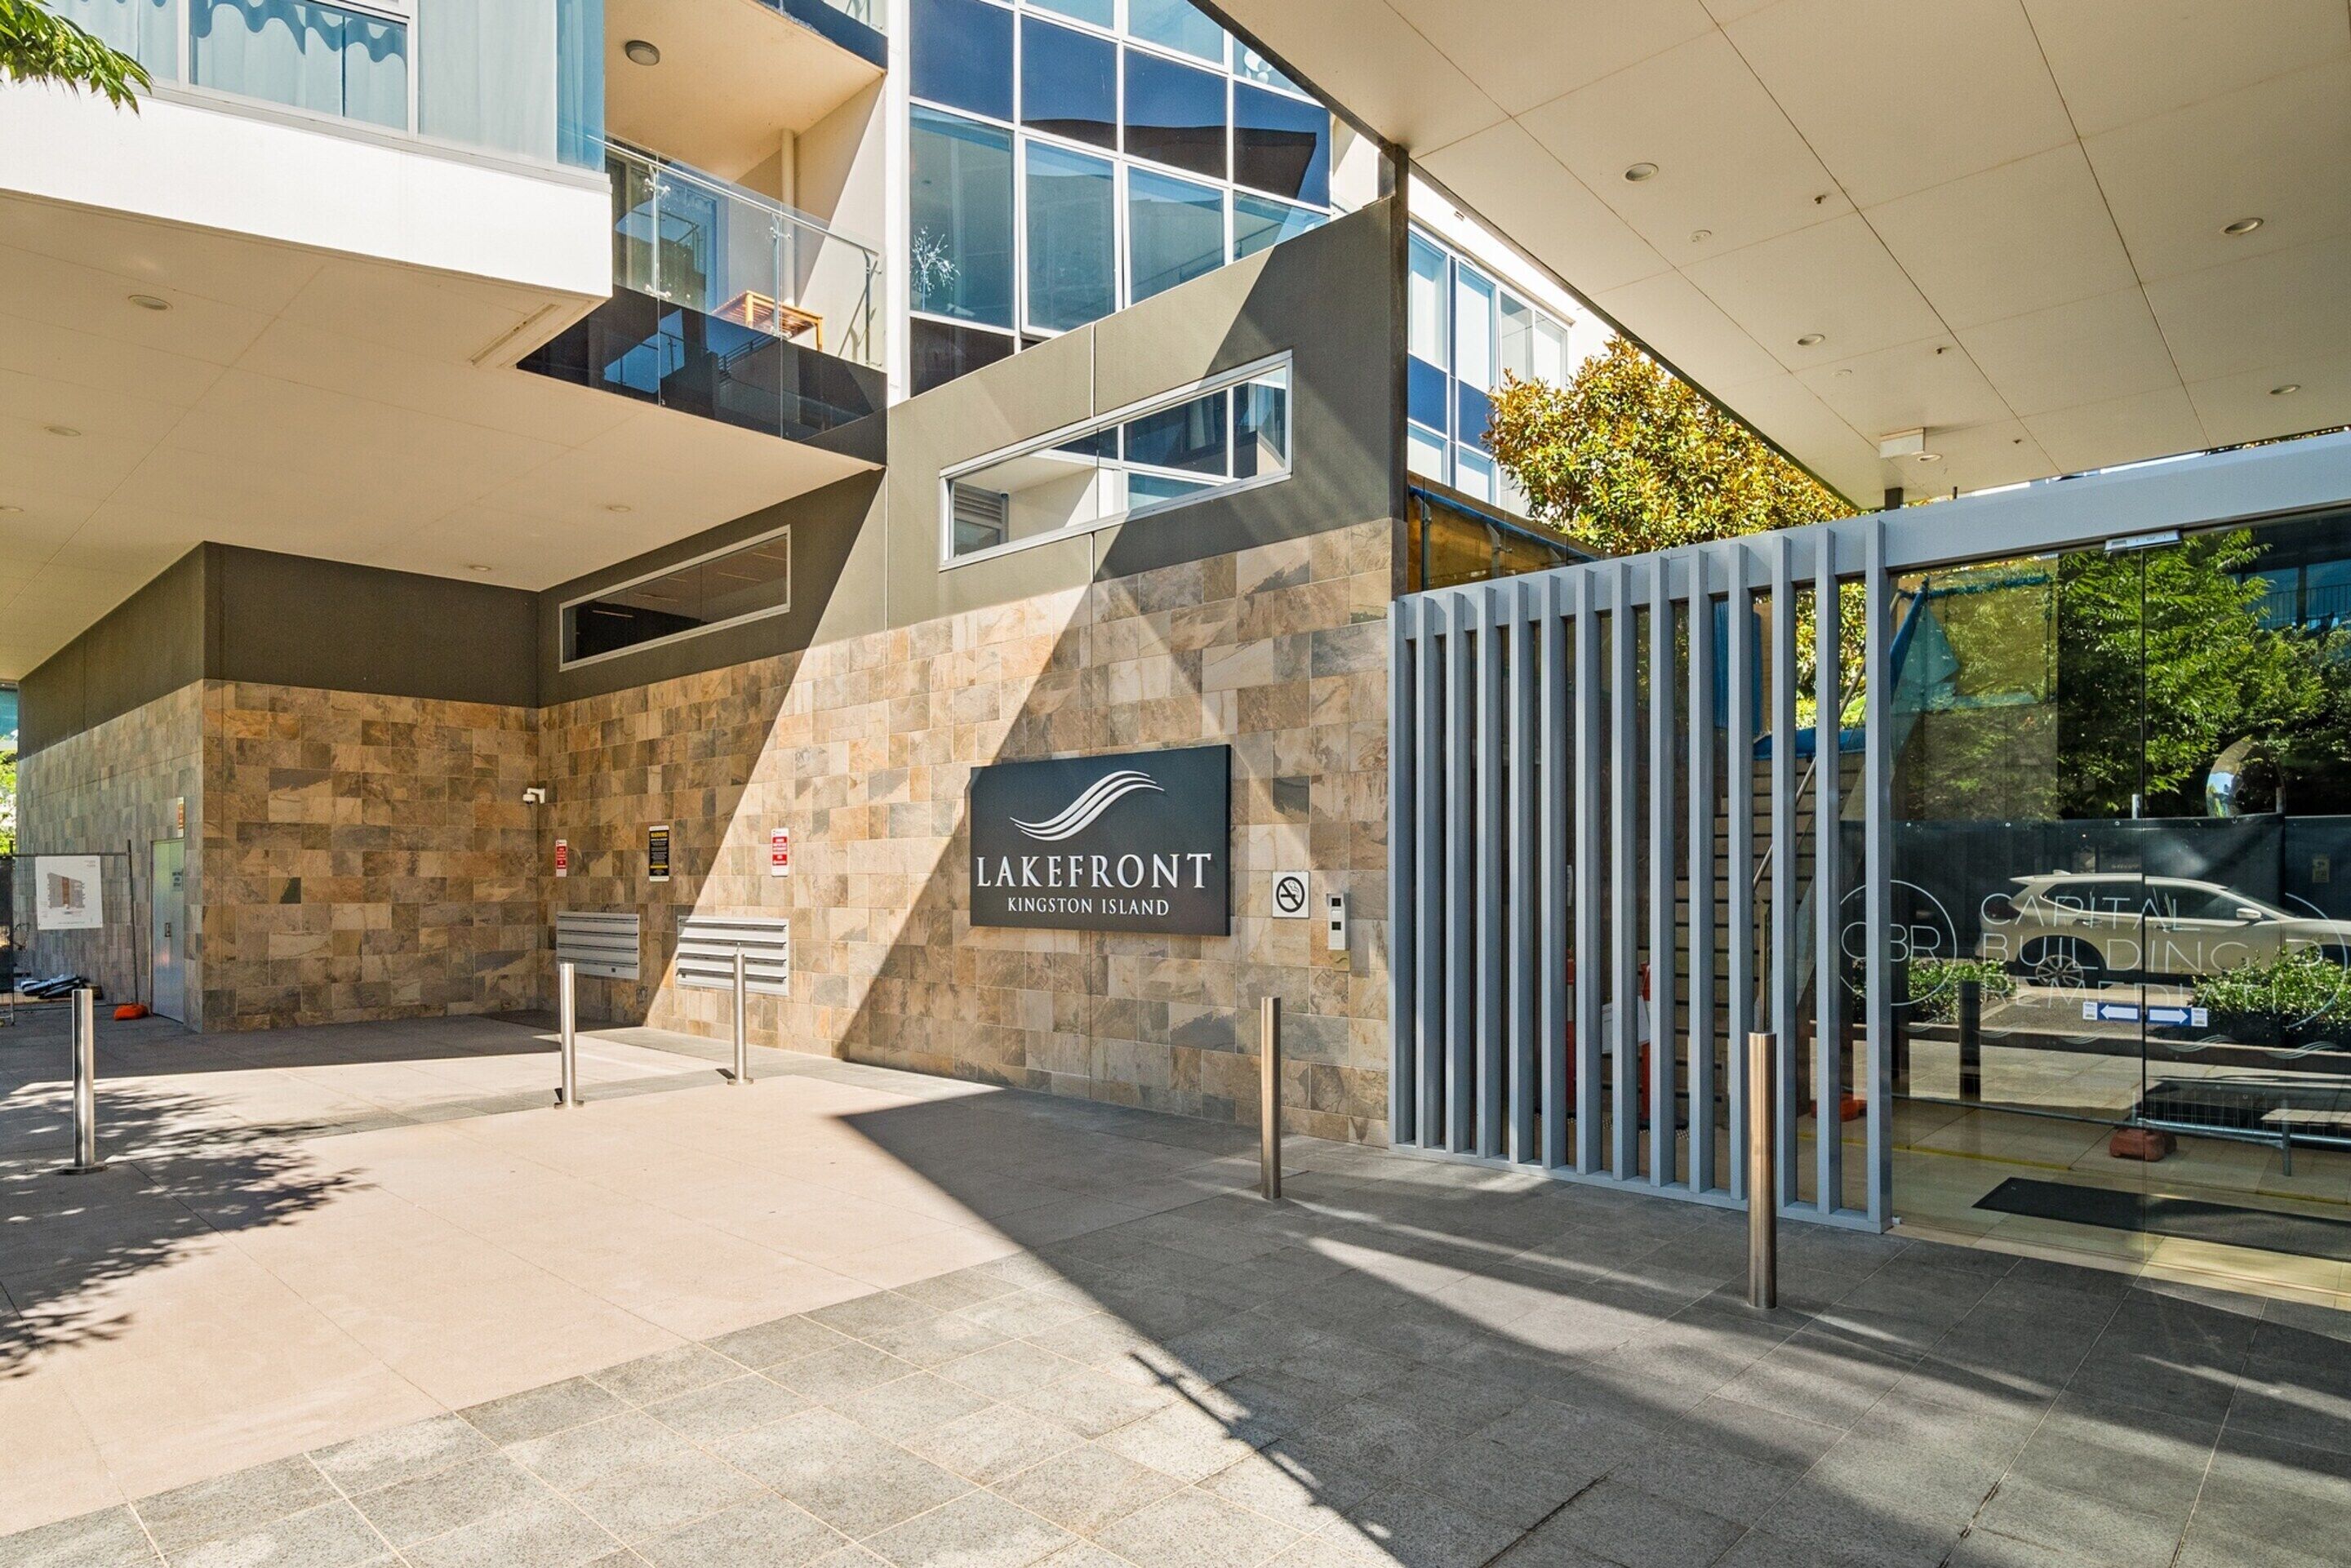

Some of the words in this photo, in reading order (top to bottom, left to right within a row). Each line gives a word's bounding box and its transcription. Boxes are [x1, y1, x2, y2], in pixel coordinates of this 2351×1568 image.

[976, 852, 1212, 888] LAKEFRONT
[1007, 897, 1092, 913] KINGSTON
[1102, 899, 1170, 917] ISLAND
[1981, 893, 2201, 933] CAPITAL
[1983, 933, 2251, 974] BUILDING
